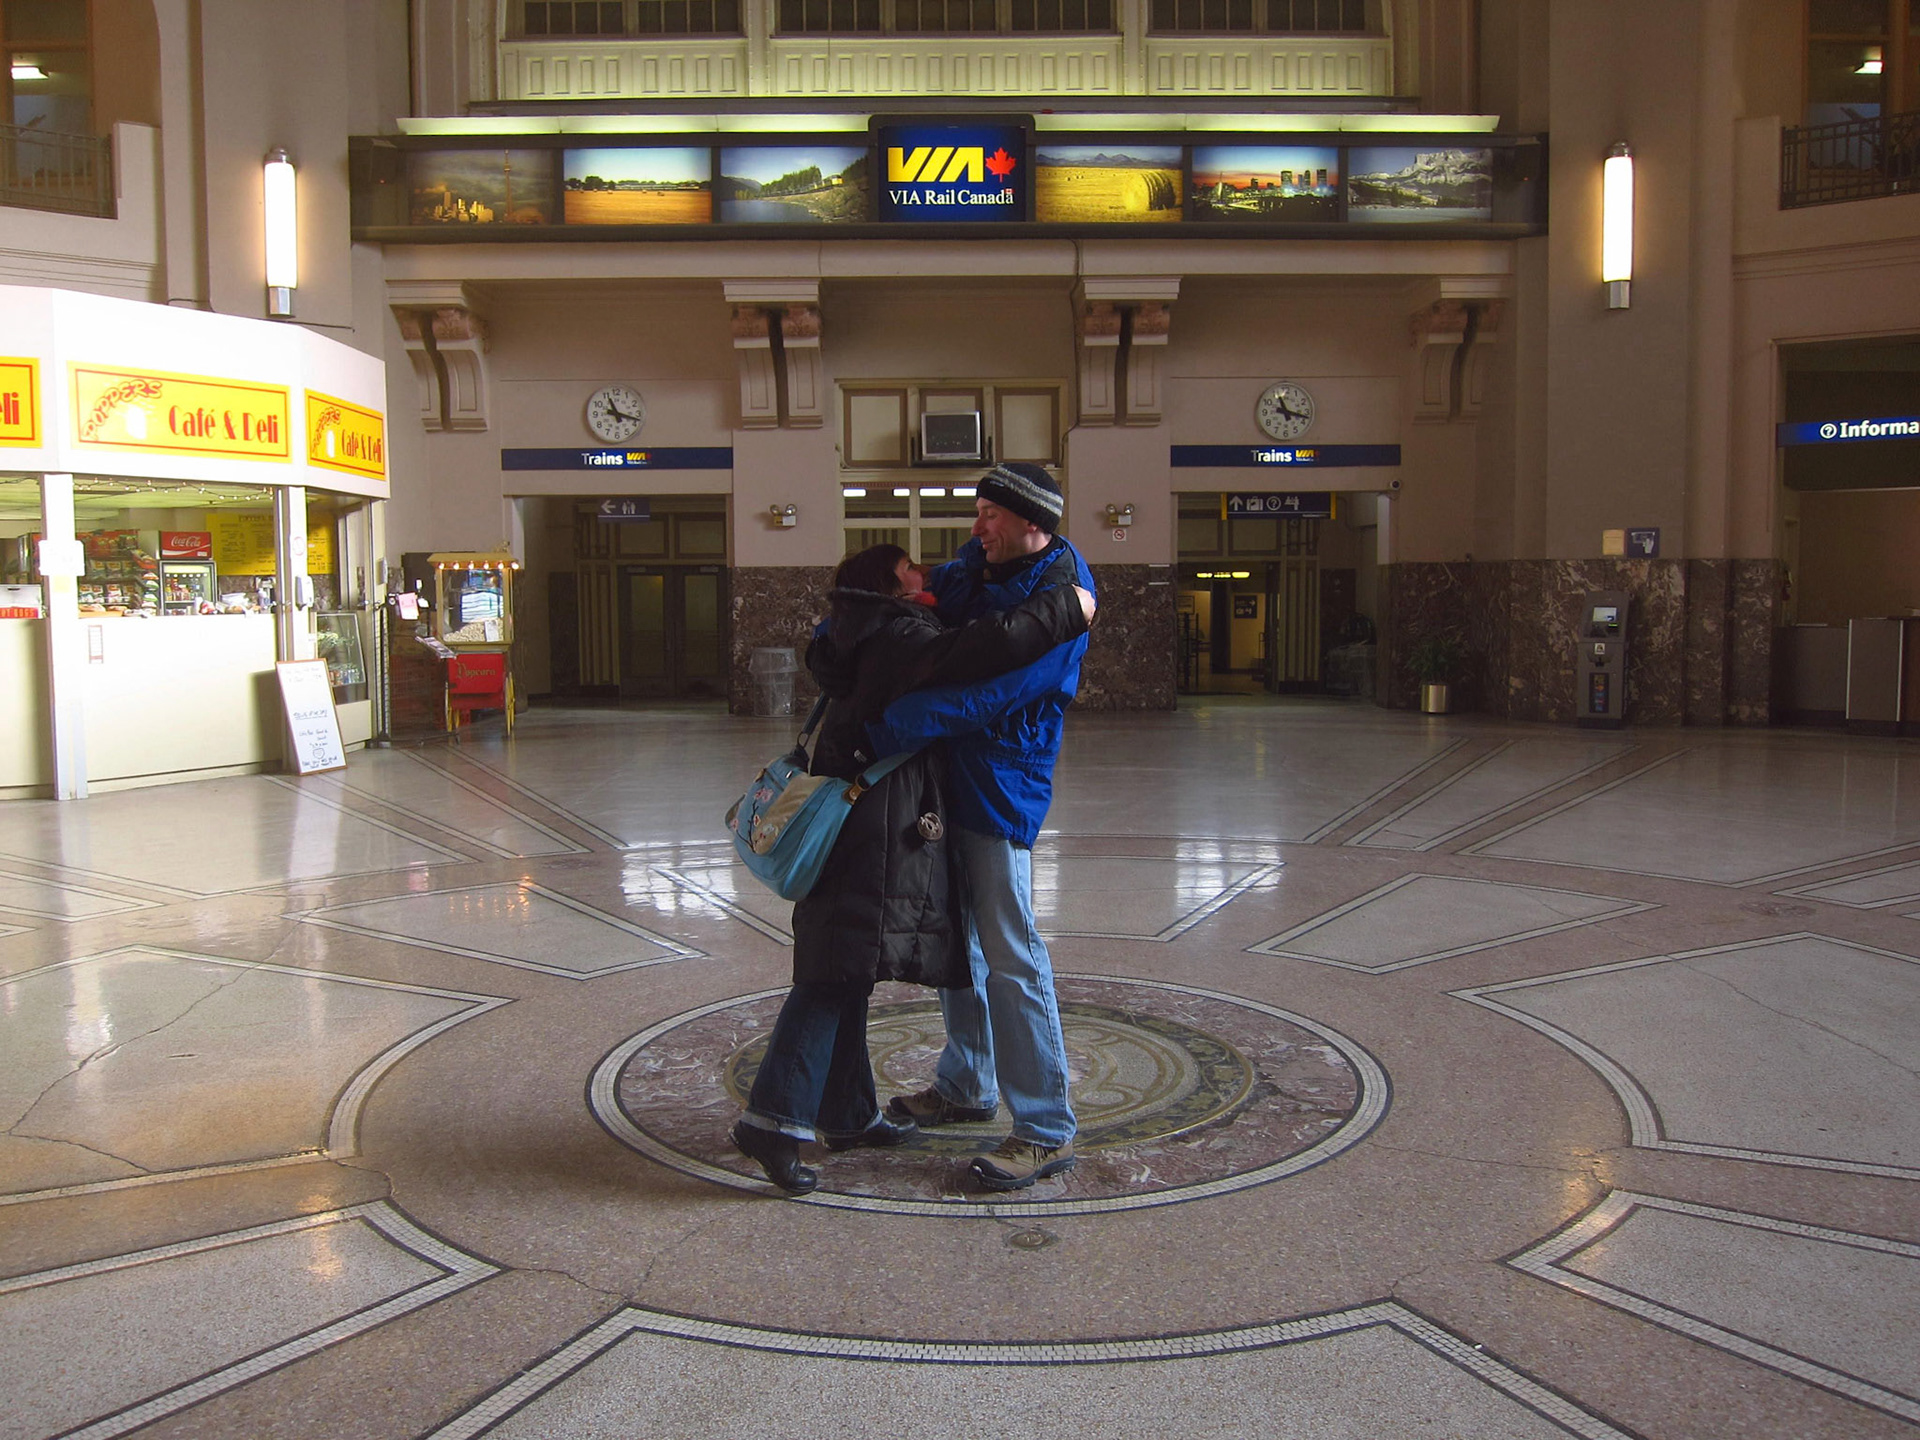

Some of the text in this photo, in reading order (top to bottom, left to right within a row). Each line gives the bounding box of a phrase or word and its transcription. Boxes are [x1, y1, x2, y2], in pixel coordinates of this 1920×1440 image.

[887, 146, 984, 183] VIA
[889, 189, 1014, 205] VIA Rail Canada
[0, 391, 20, 425] li
[82, 379, 163, 441] POPPERS
[168, 405, 278, 444] Café & Deli
[1839, 420, 1920, 438] Informa
[341, 429, 359, 458] Café
[1250, 449, 1292, 462] Trains
[581, 452, 624, 465] Trains
[455, 661, 496, 680] Popcorn
